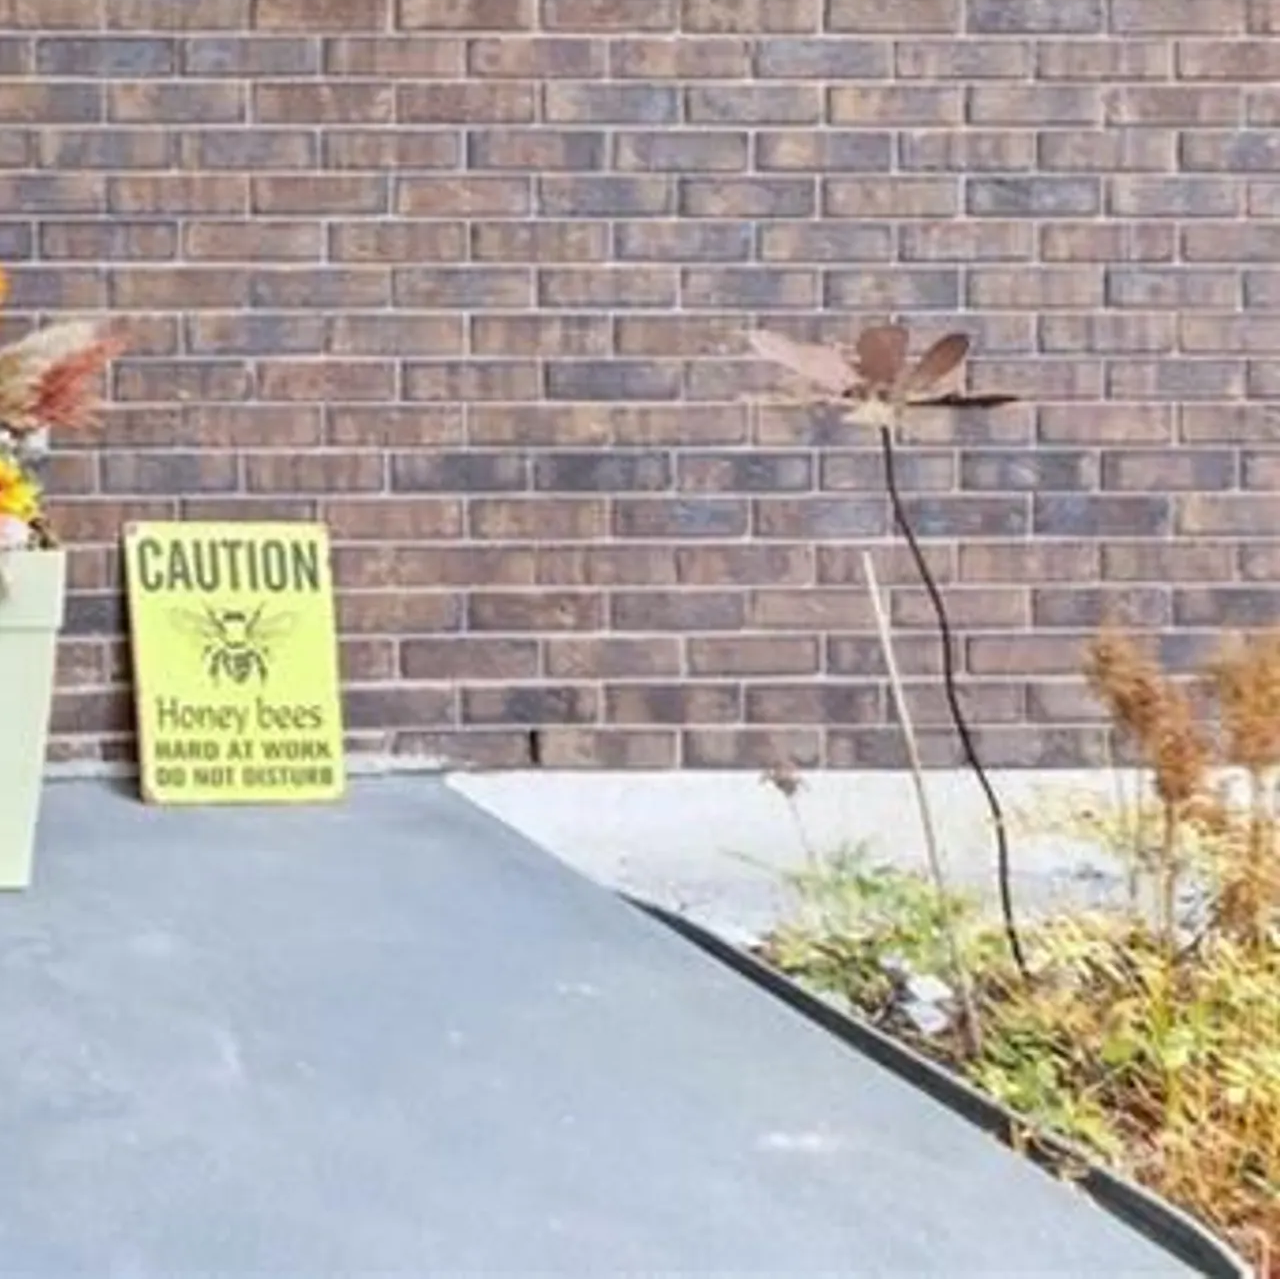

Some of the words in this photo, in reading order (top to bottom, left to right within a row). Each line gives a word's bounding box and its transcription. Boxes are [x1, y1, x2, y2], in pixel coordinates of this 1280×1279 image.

[136, 537, 320, 593] CAUTION
[154, 694, 248, 734] Honey
[255, 694, 323, 730] bees
[154, 739, 220, 760] HARD
[225, 739, 254, 760] AT
[260, 739, 332, 760] WORK
[154, 767, 187, 787] DO
[193, 767, 236, 787] NOT
[242, 766, 334, 787] DISTURB
